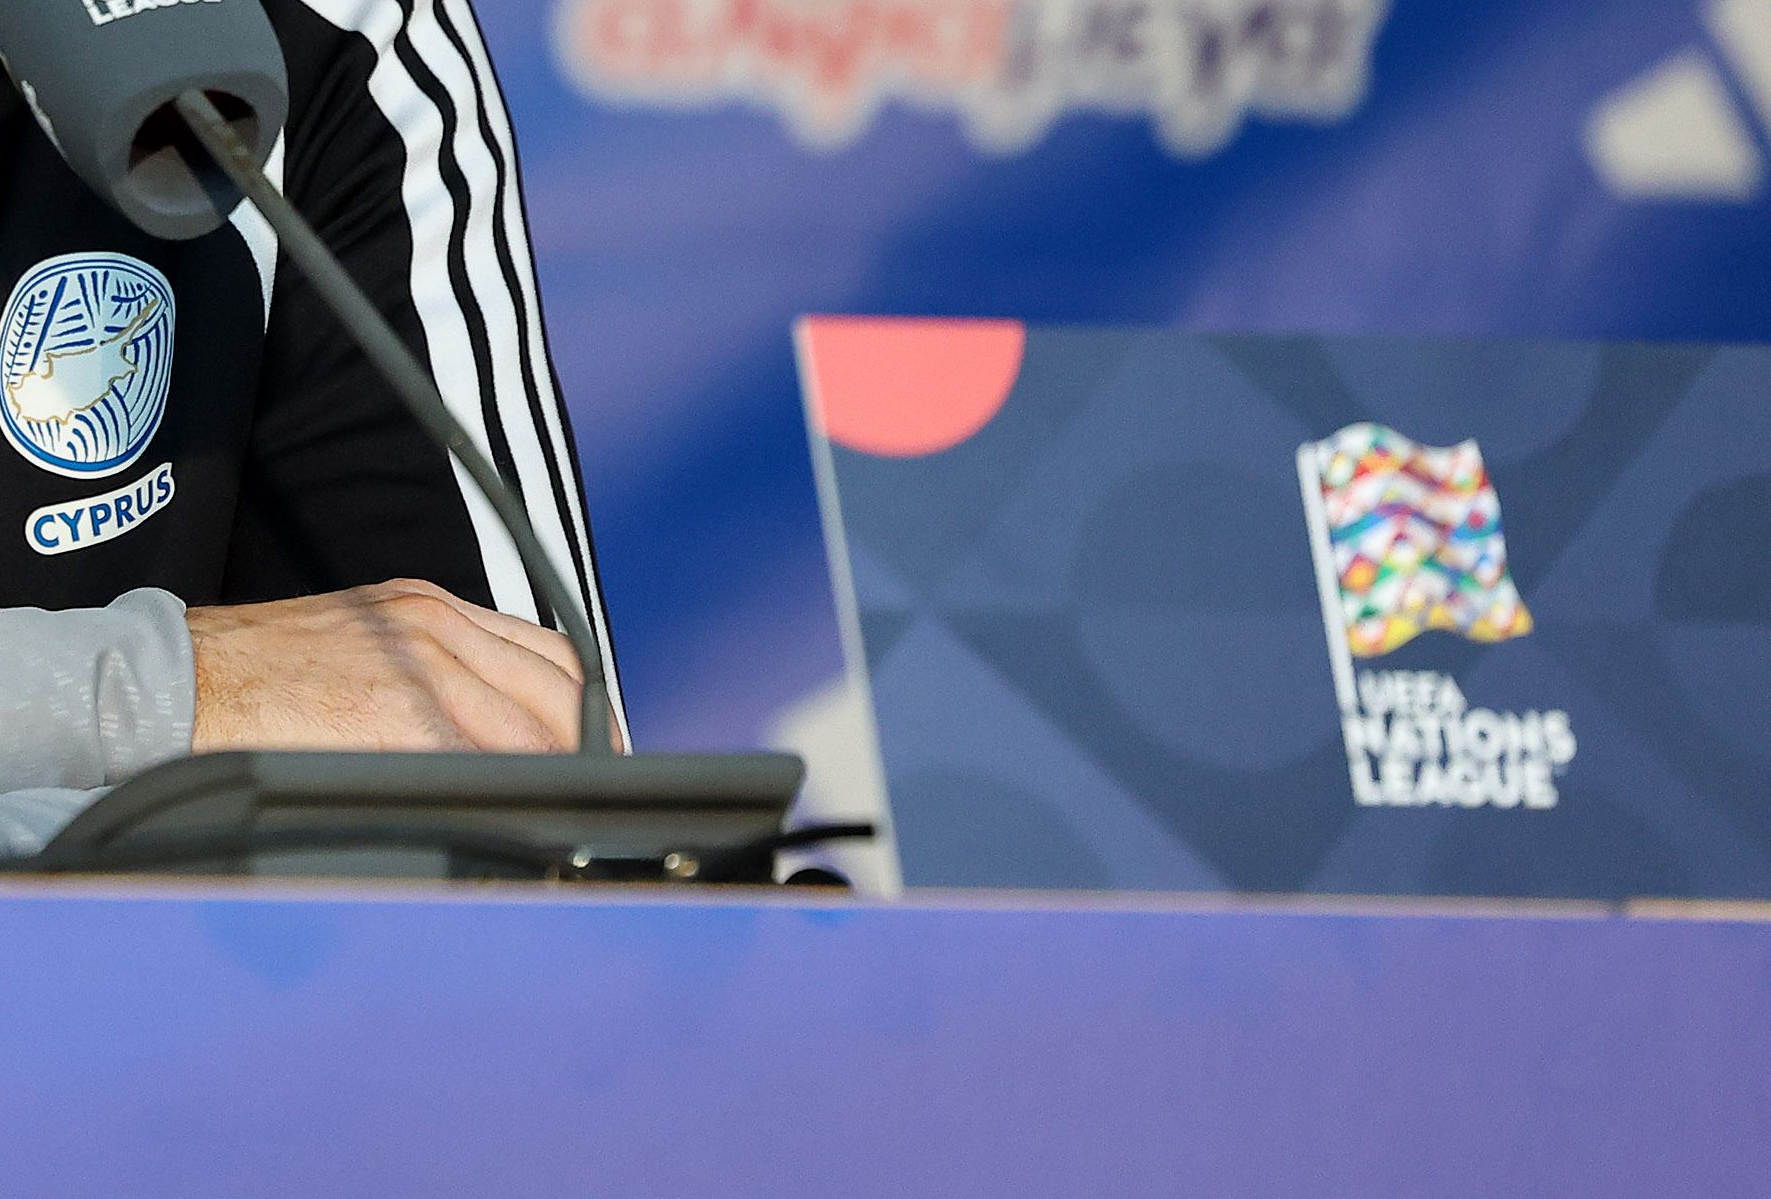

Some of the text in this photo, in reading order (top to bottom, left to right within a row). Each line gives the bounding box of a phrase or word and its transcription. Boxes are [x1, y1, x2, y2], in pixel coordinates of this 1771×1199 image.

[32, 469, 171, 548] CYPRUS
[1358, 669, 1469, 715] UEFA
[1342, 708, 1578, 765] NATIONS
[1349, 754, 1560, 809] LEAGUE
